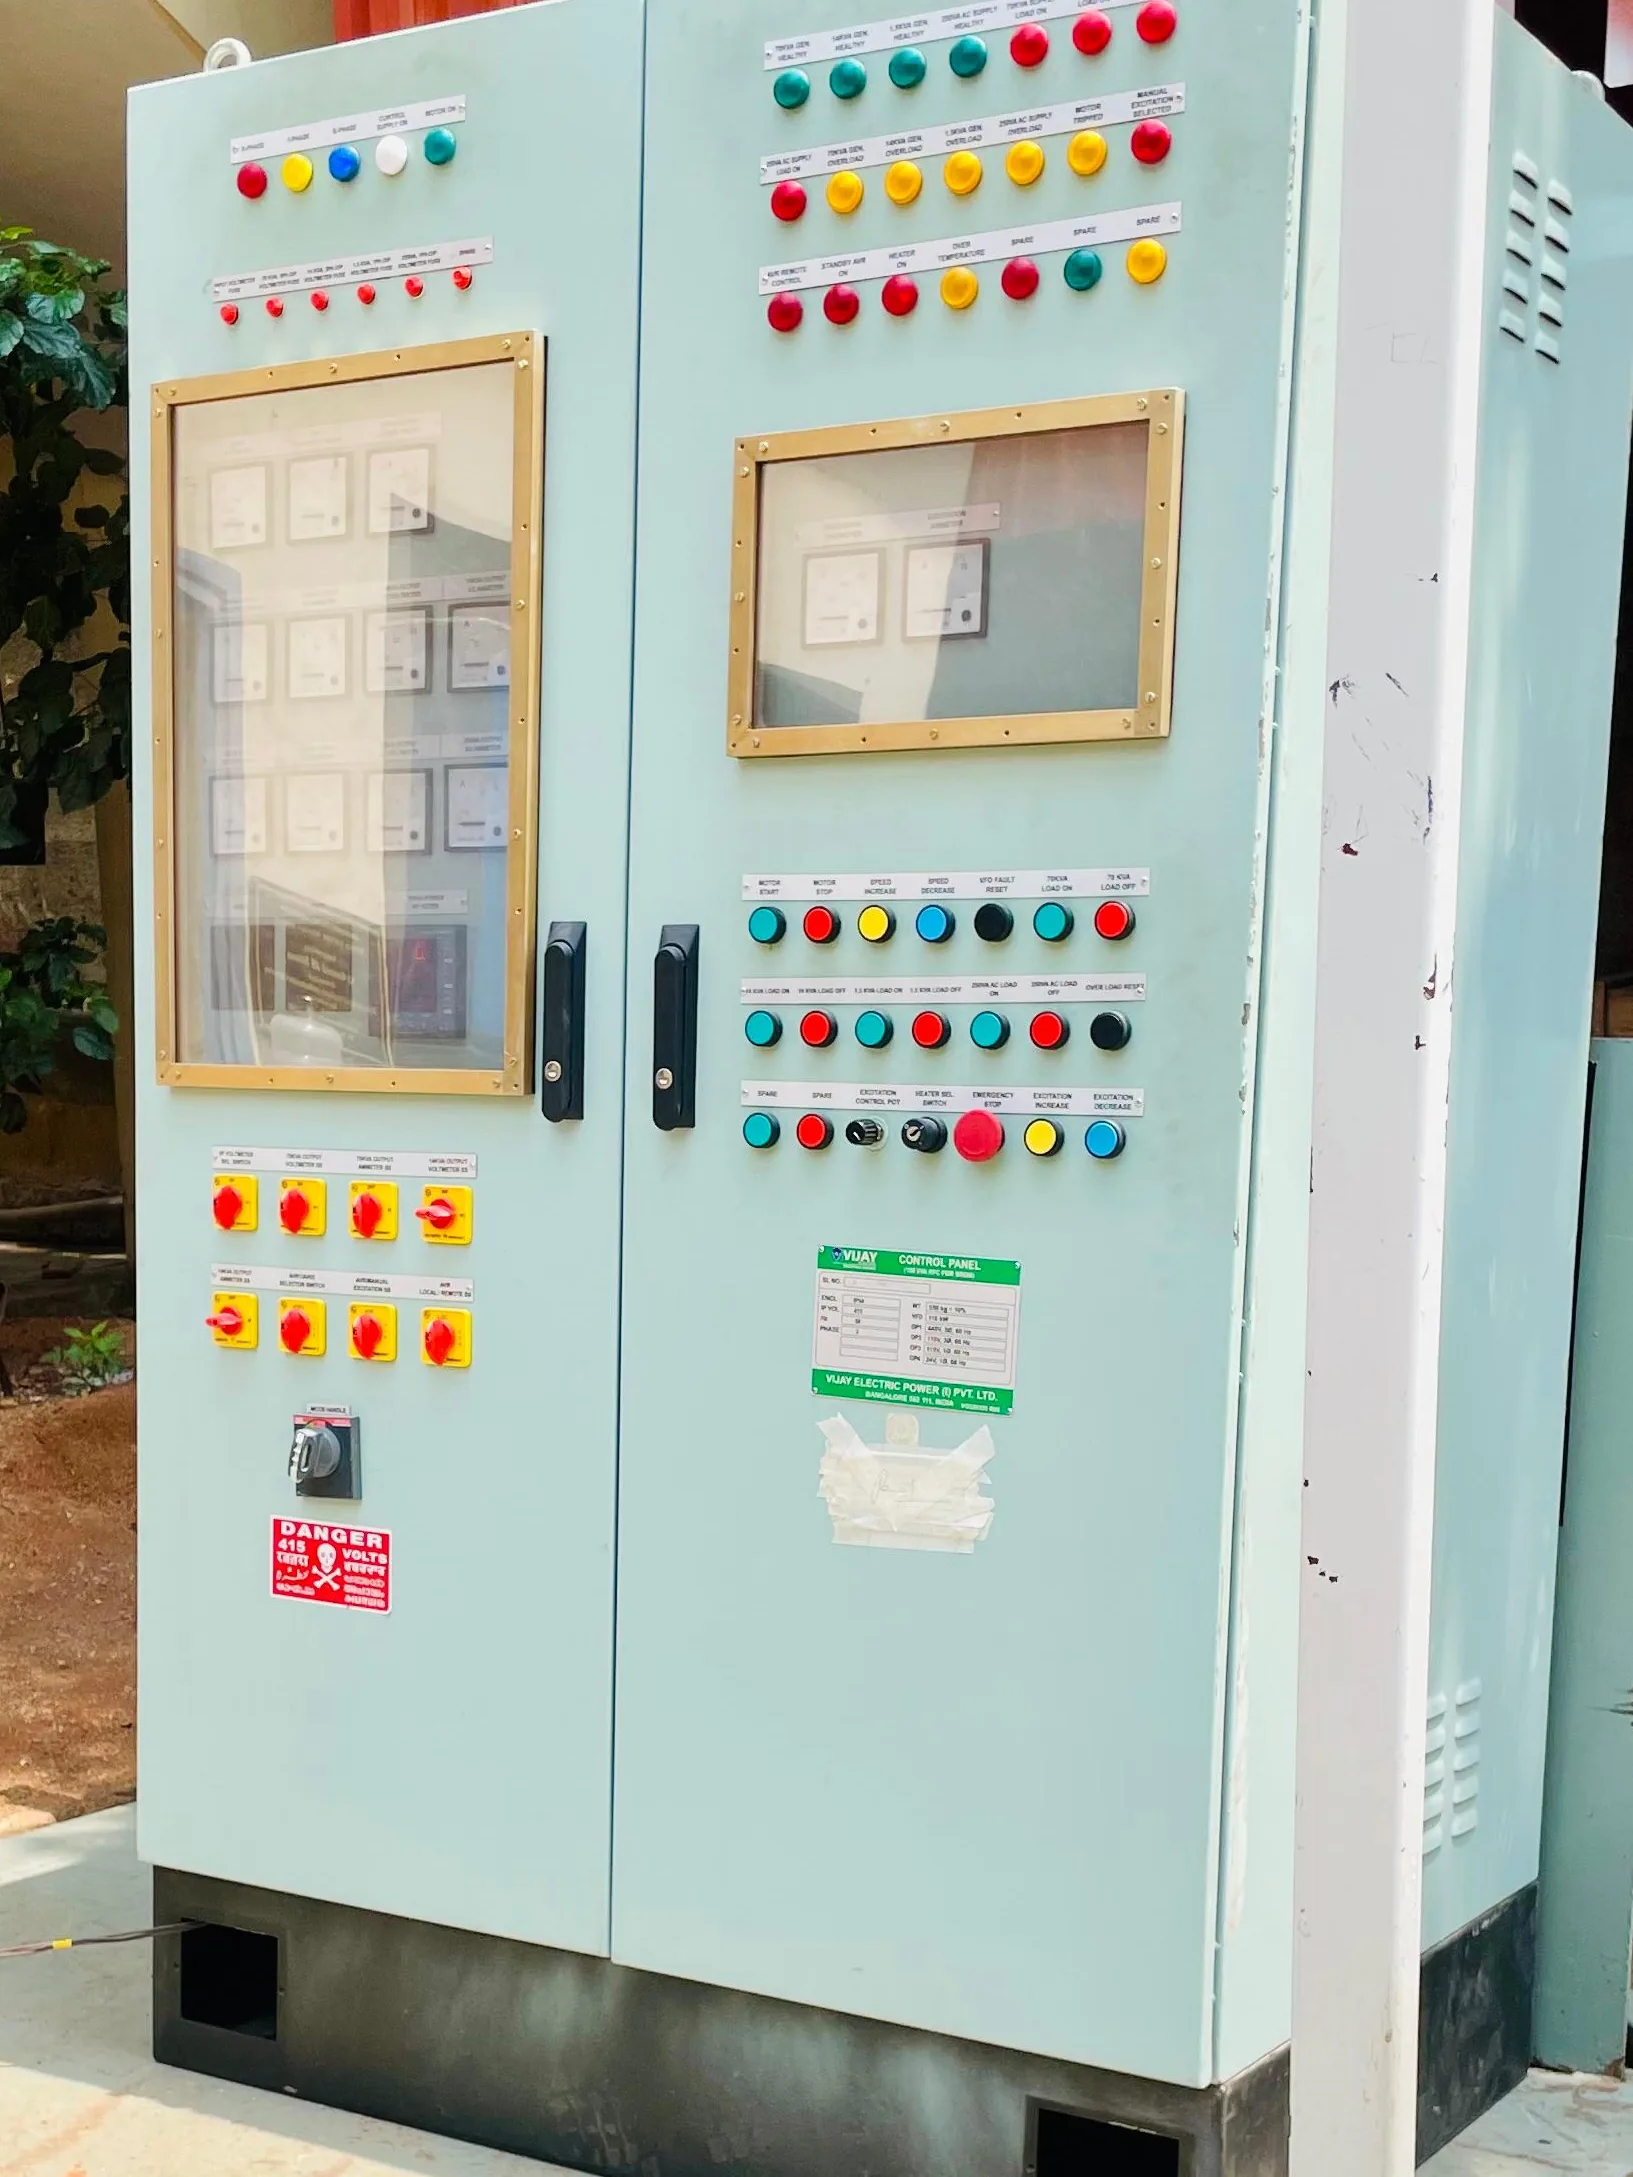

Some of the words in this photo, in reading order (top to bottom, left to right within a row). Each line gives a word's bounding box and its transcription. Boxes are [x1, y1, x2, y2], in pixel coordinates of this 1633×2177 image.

[893, 30, 925, 40] HEALTHY
[835, 41, 865, 51] HEALTHY
[777, 51, 807, 61] HEALTHY
[1075, 103, 1101, 113] MOTOR
[1133, 105, 1172, 117] SELECTED
[1073, 113, 1104, 124] TRIPPED
[1007, 123, 1043, 136] OVERLOAD
[945, 134, 983, 147] OVERLOAD
[885, 145, 923, 157] OVERLOAD
[827, 155, 865, 167] OVERLOAD
[1136, 215, 1161, 226] SPARE
[1073, 226, 1097, 237] SPARE
[1011, 236, 1035, 247] SPARE
[888, 249, 916, 260] HEATER
[938, 249, 986, 262] TEMPERATURE
[820, 259, 852, 270] STANDBY
[771, 276, 802, 287] CONTROL
[869, 878, 892, 886] SPEED
[927, 877, 950, 885] SPEED
[759, 888, 780, 896] START
[816, 888, 834, 896] STOP
[920, 886, 956, 894] DECREASE
[985, 885, 1009, 893] RESET
[1100, 883, 1121, 891] LOAD
[1060, 980, 1078, 988] LOAD
[914, 1090, 940, 1098] HEATER
[972, 1091, 1014, 1099] EMERGENCY
[1033, 1092, 1073, 1100] EXCITATION
[1093, 1093, 1134, 1101] EXCITATION
[855, 1098, 886, 1106] CONTROL
[922, 1099, 947, 1107] SWITCH
[1093, 1102, 1132, 1110] DECREASE
[842, 1249, 877, 1262] VIJAY
[899, 1254, 947, 1268] CONTROL
[948, 1258, 981, 1271] PANEL
[825, 1373, 853, 1385] VIJAY
[853, 1377, 901, 1390] ELECTRIC
[903, 1381, 940, 1395] POWER
[953, 1388, 976, 1400] PVT.
[976, 1391, 998, 1402] LTD.
[865, 1390, 908, 1402] BANGALORE
[280, 1520, 383, 1549] DANGER
[278, 1537, 306, 1553] 415
[342, 1547, 388, 1565] VOLTS
